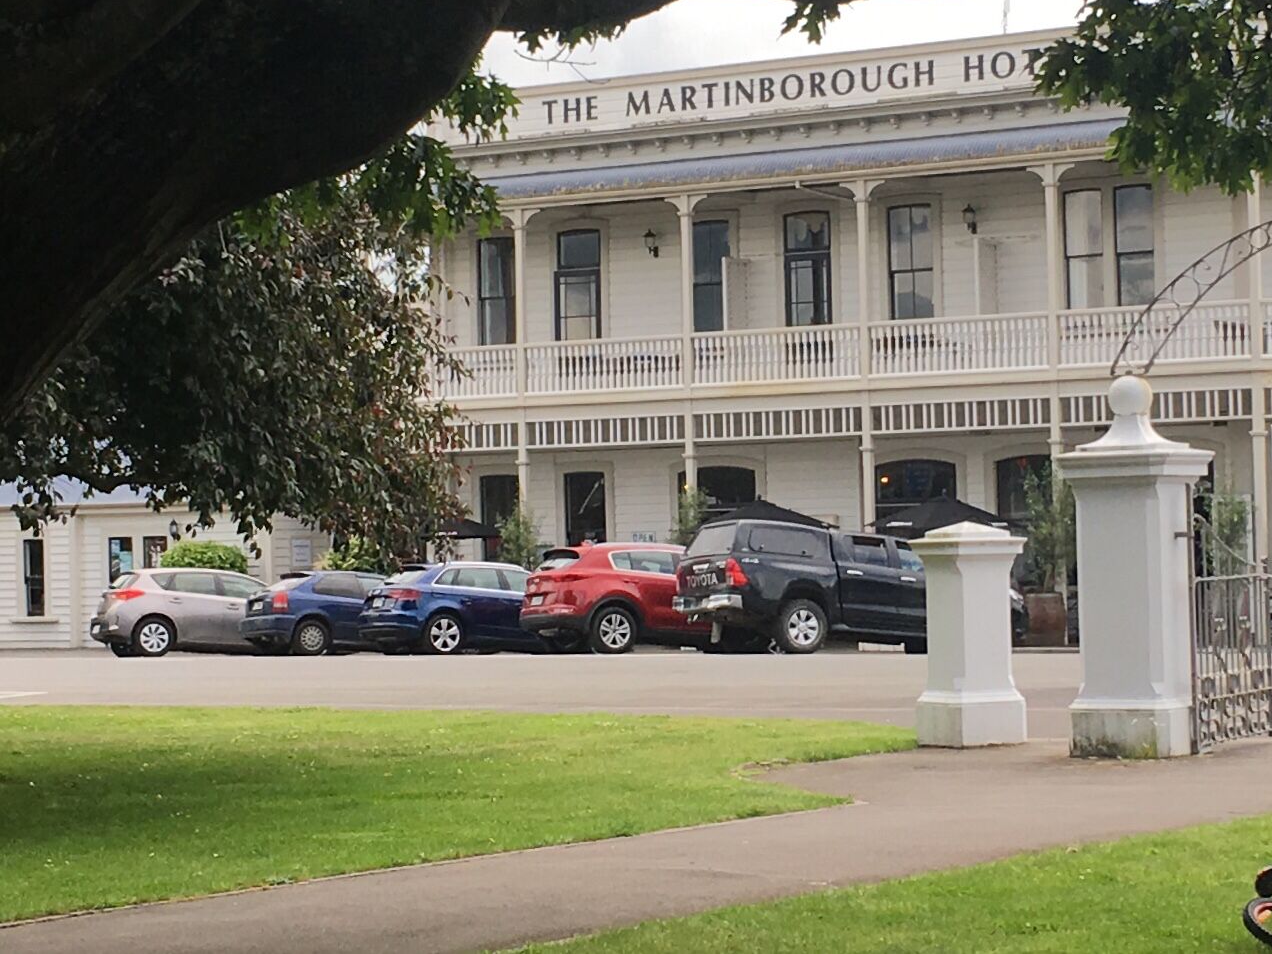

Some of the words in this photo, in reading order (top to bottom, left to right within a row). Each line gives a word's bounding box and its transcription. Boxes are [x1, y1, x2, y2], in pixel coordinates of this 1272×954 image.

[541, 95, 599, 125] THE
[625, 60, 936, 117] MARTINBOROUGH
[963, 48, 1040, 82] HOT
[632, 532, 654, 543] OPEN
[686, 572, 719, 589] TOYOTA
